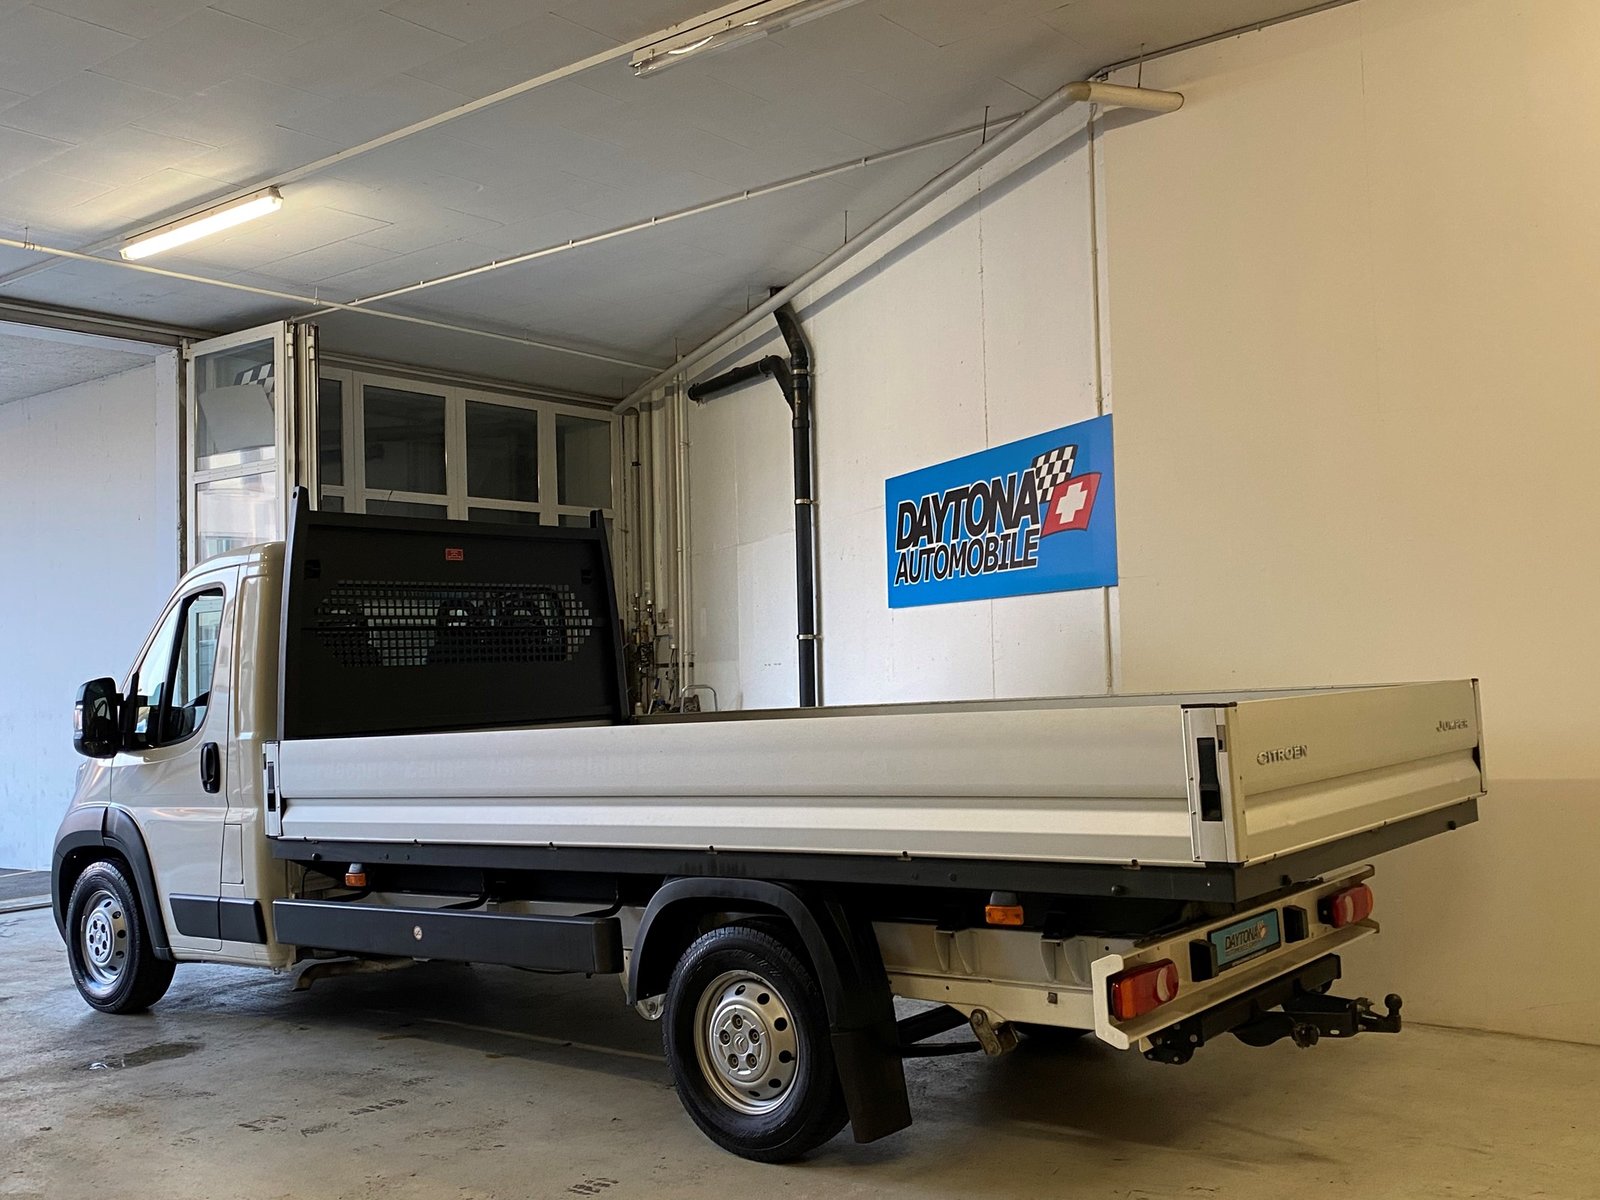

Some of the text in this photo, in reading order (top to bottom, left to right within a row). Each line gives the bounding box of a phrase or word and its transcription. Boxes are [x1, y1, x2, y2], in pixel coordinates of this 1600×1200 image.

[896, 468, 1040, 551] DAYTONA
[894, 527, 1040, 587] AUTOMOBILE
[1225, 924, 1260, 951] DAYTONA
